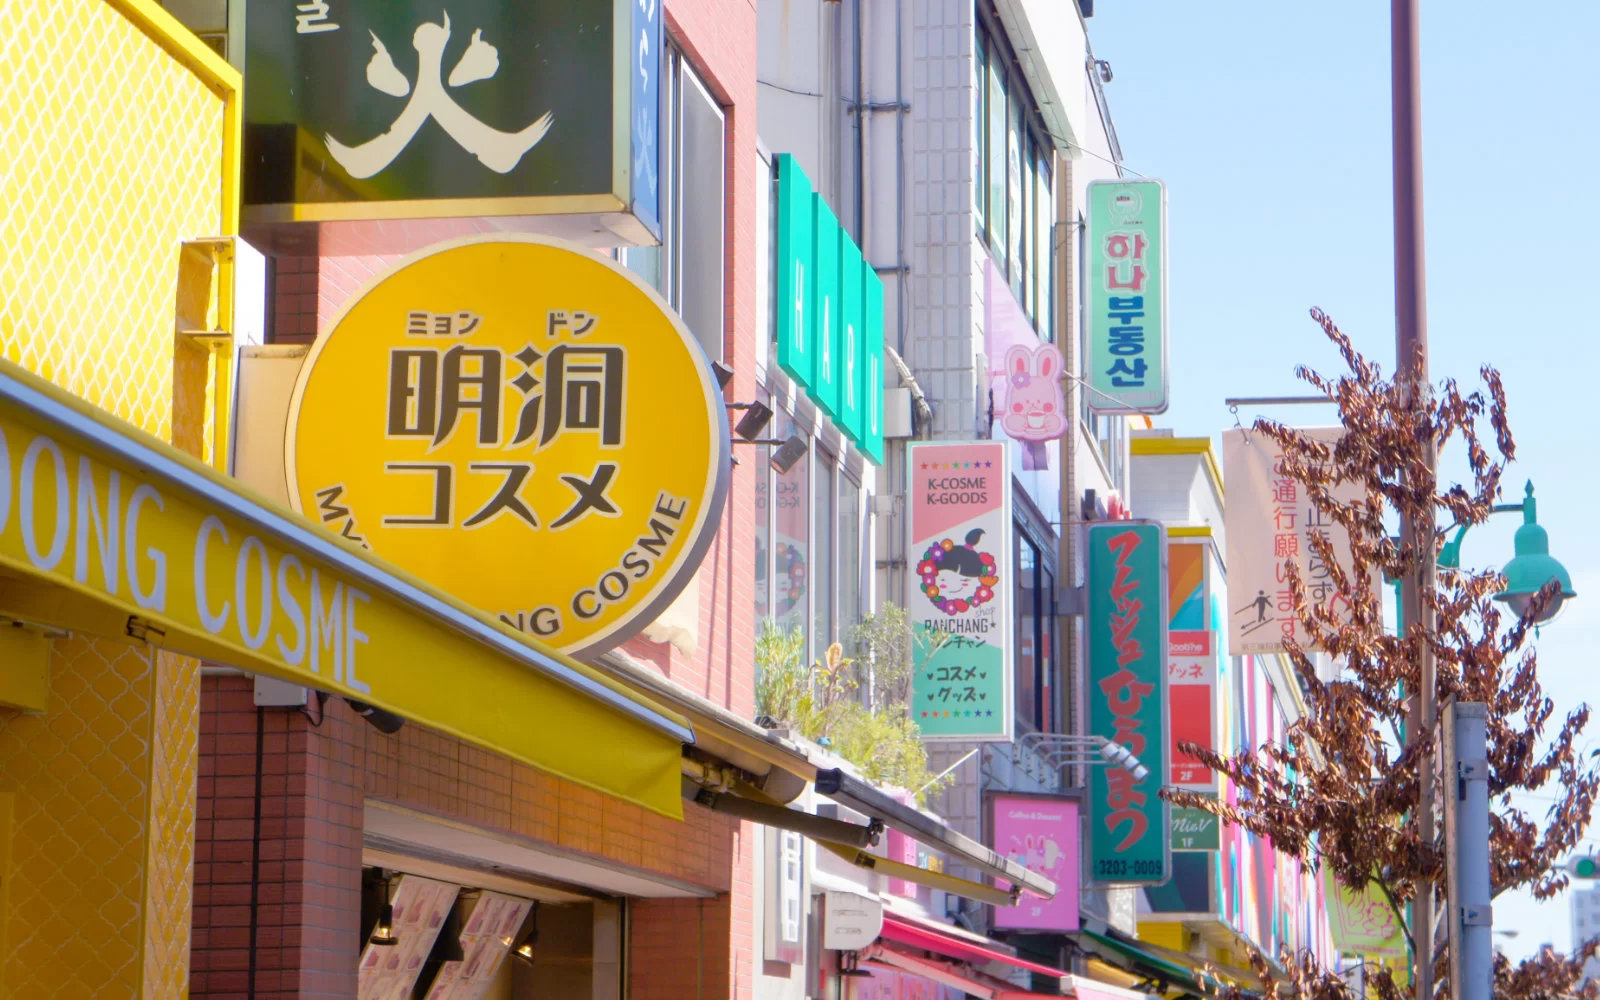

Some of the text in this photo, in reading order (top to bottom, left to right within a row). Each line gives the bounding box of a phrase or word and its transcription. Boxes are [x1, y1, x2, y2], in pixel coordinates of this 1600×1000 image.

[407, 312, 480, 335] ミョン
[548, 312, 595, 335] ドン
[795, 257, 878, 436] HARU
[1106, 296, 1148, 387] 부동산
[387, 345, 624, 448] 明洞
[927, 477, 986, 490] K-COSME
[384, 464, 619, 528] コスメ
[926, 492, 987, 504] K-GOODS
[0, 427, 371, 694] ONG COSME
[572, 492, 688, 619] COSME
[925, 618, 988, 633] RANCHANG
[936, 635, 986, 648] ンチャン
[937, 666, 977, 681] コスメ
[938, 687, 977, 702] グッズ
[1181, 771, 1193, 781] 2F
[1182, 838, 1194, 848] 1F
[1099, 859, 1163, 875] 3203-0009
